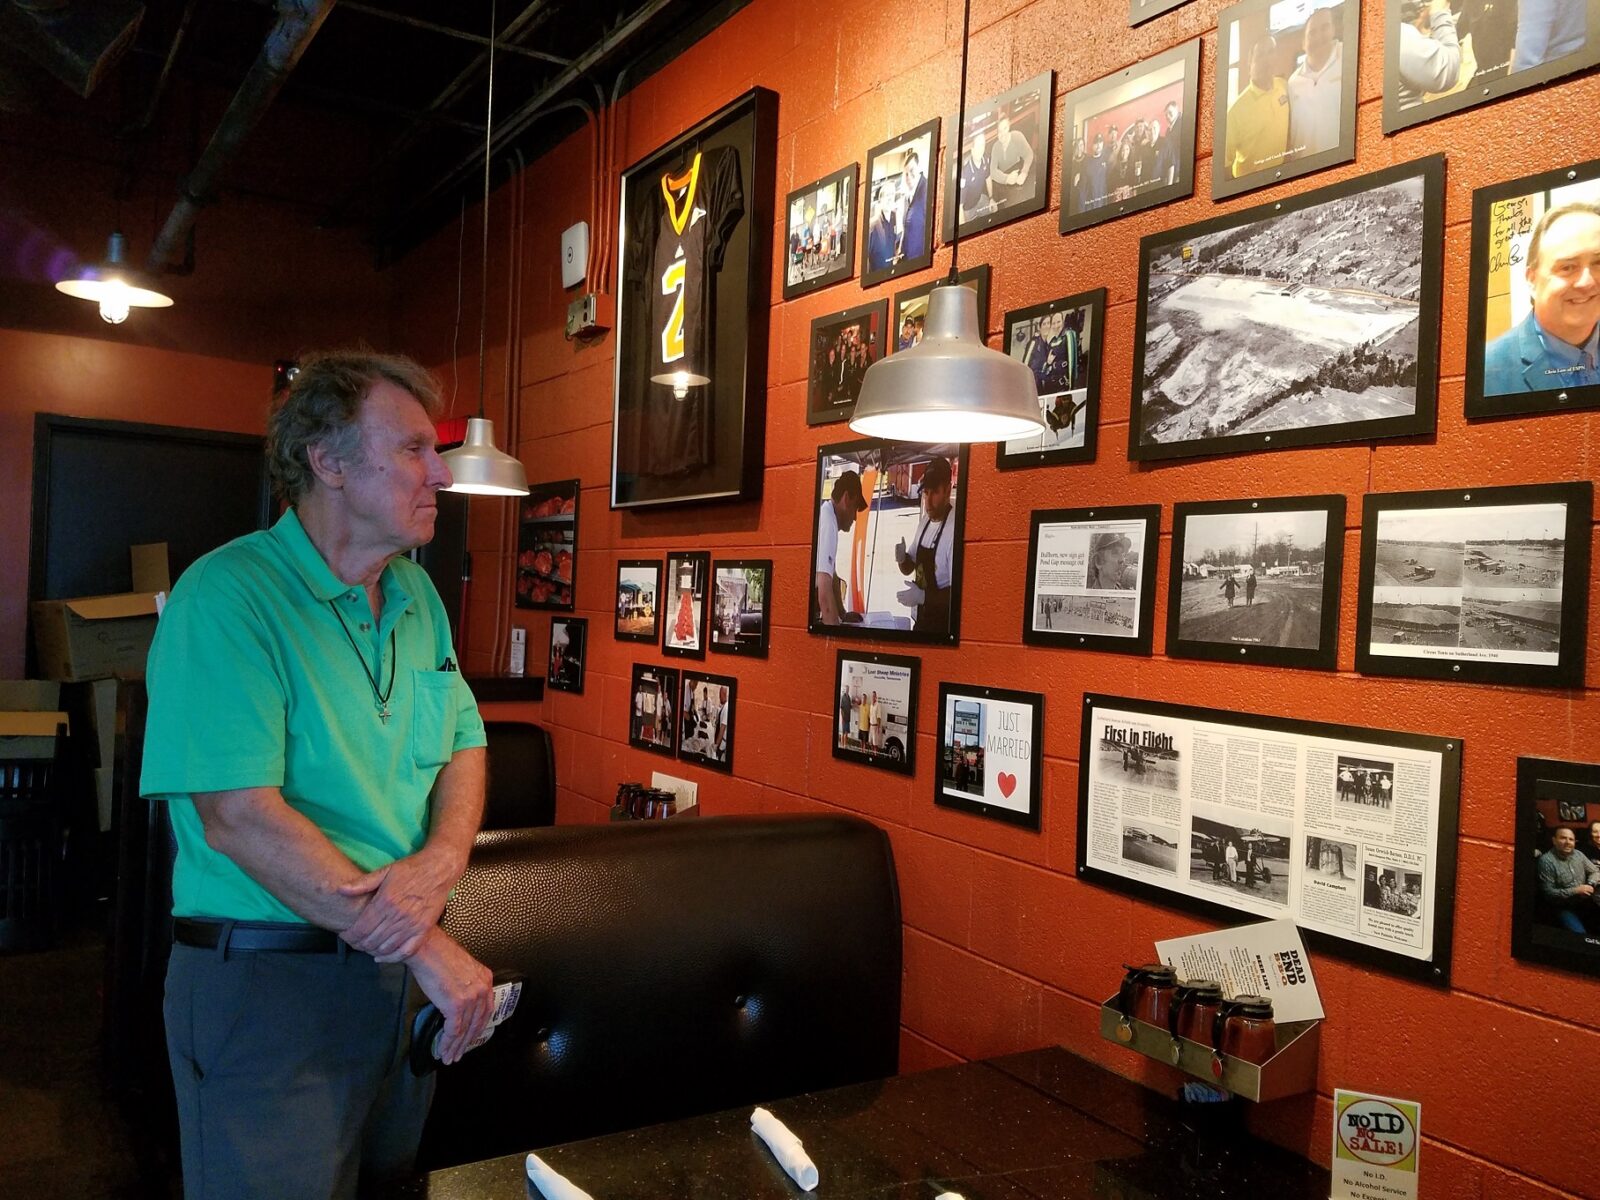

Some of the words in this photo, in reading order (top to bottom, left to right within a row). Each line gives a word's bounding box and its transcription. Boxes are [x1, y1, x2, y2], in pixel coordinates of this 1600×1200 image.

[998, 710, 1021, 733] JUST
[986, 734, 1030, 761] MARRIED
[1104, 725, 1127, 743] First
[1129, 728, 1140, 745] in
[1142, 730, 1173, 750] Flight
[1326, 881, 1347, 891] Campbell
[1256, 954, 1266, 974] BEER
[1262, 974, 1271, 991] LIST
[1279, 950, 1298, 986] END
[1290, 949, 1307, 984] DEAD
[1347, 1114, 1371, 1128] NO
[1369, 1112, 1405, 1134] ID
[1356, 1126, 1375, 1140] NO
[1349, 1137, 1404, 1156] SALE!
[1343, 1178, 1354, 1186] No
[1355, 1181, 1381, 1191] Alcohol
[1382, 1186, 1407, 1196] Service
[1351, 1191, 1361, 1199] No
